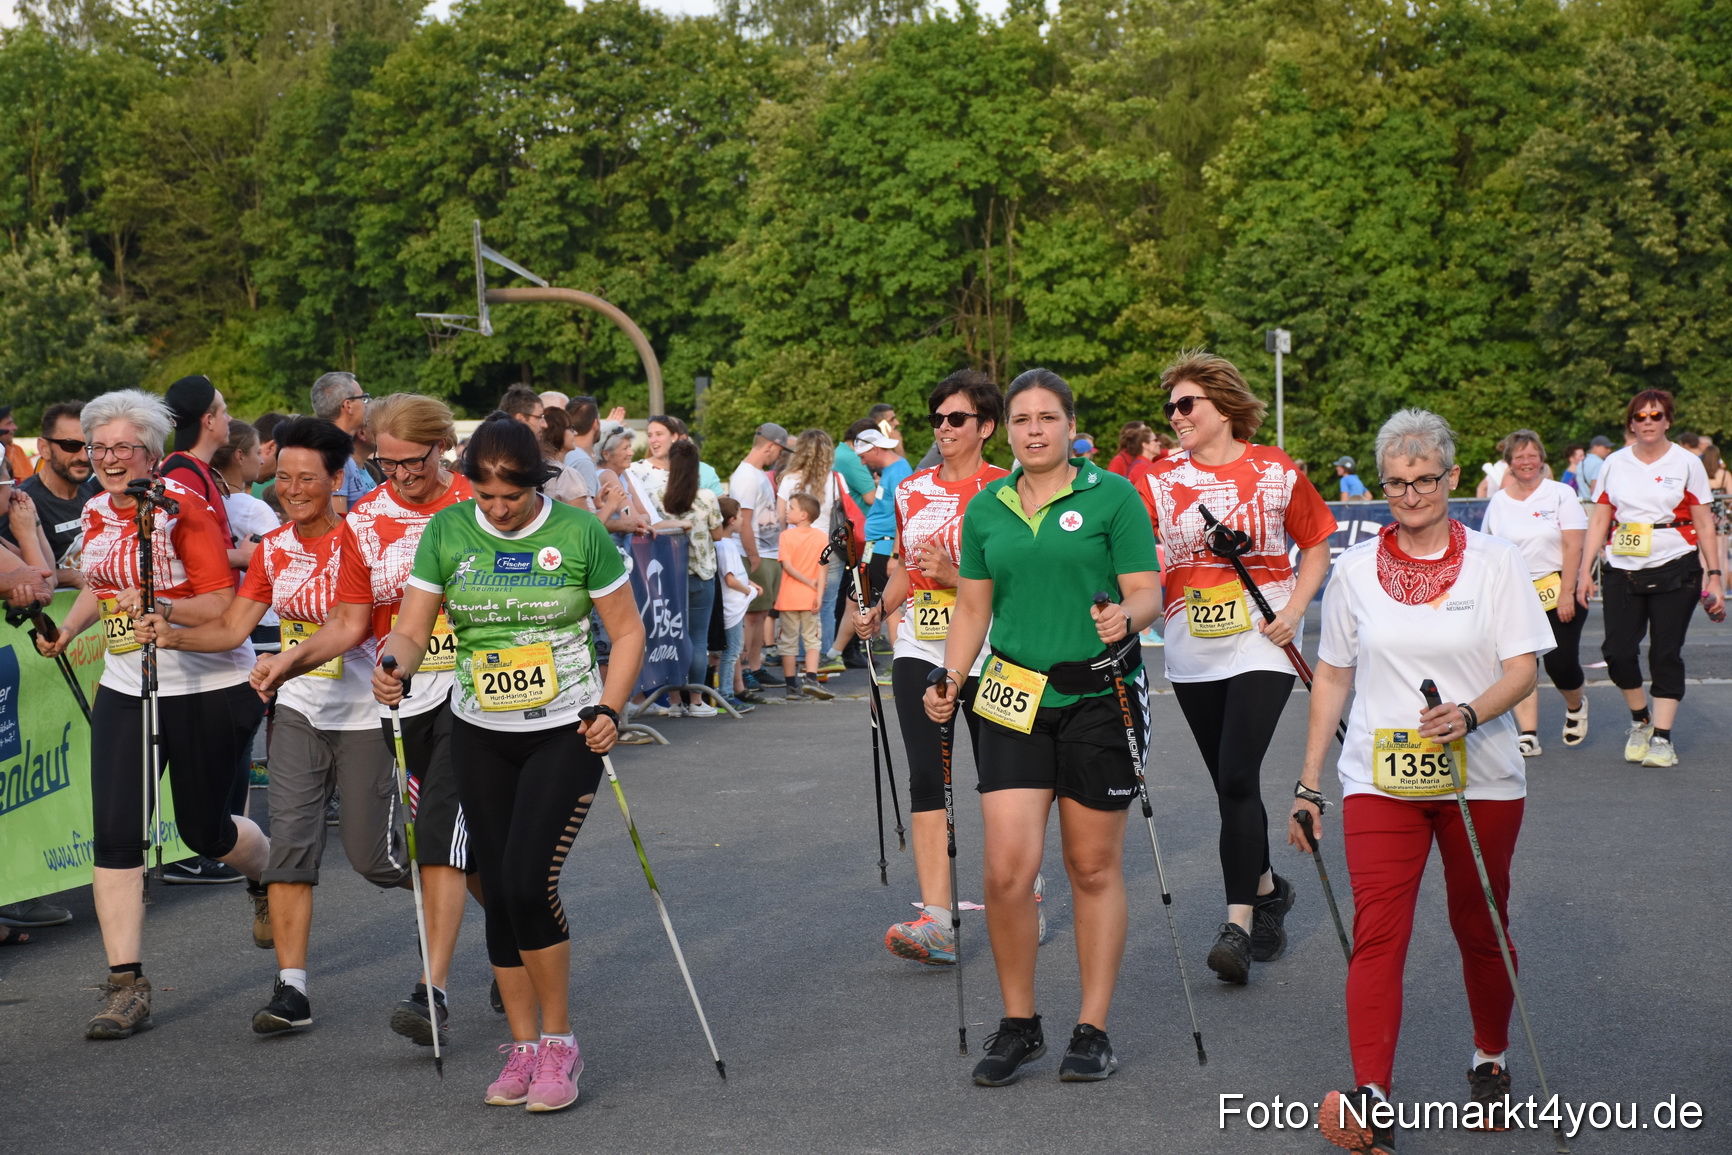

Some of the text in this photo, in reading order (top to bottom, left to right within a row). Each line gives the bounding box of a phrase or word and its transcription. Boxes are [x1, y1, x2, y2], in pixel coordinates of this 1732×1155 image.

[1618, 534, 1641, 547] 356
[502, 558, 530, 567] Fischer
[473, 570, 568, 587] firmenlauf
[1538, 588, 1555, 602] 60
[449, 598, 559, 611] Gesunde Firmen
[1446, 599, 1475, 607] LANDKREIS
[469, 606, 567, 625] laufen länger!
[919, 607, 950, 626] 221
[1191, 600, 1236, 623] 2227
[428, 633, 457, 656] 04
[482, 666, 546, 695] 2084
[490, 692, 528, 701] Hurd-Häring
[981, 677, 1030, 713] 2085
[1386, 741, 1422, 749] firmenlauf
[1385, 753, 1451, 777] 1359
[1400, 778, 1419, 786] Riepl
[1108, 787, 1132, 796] hummel
